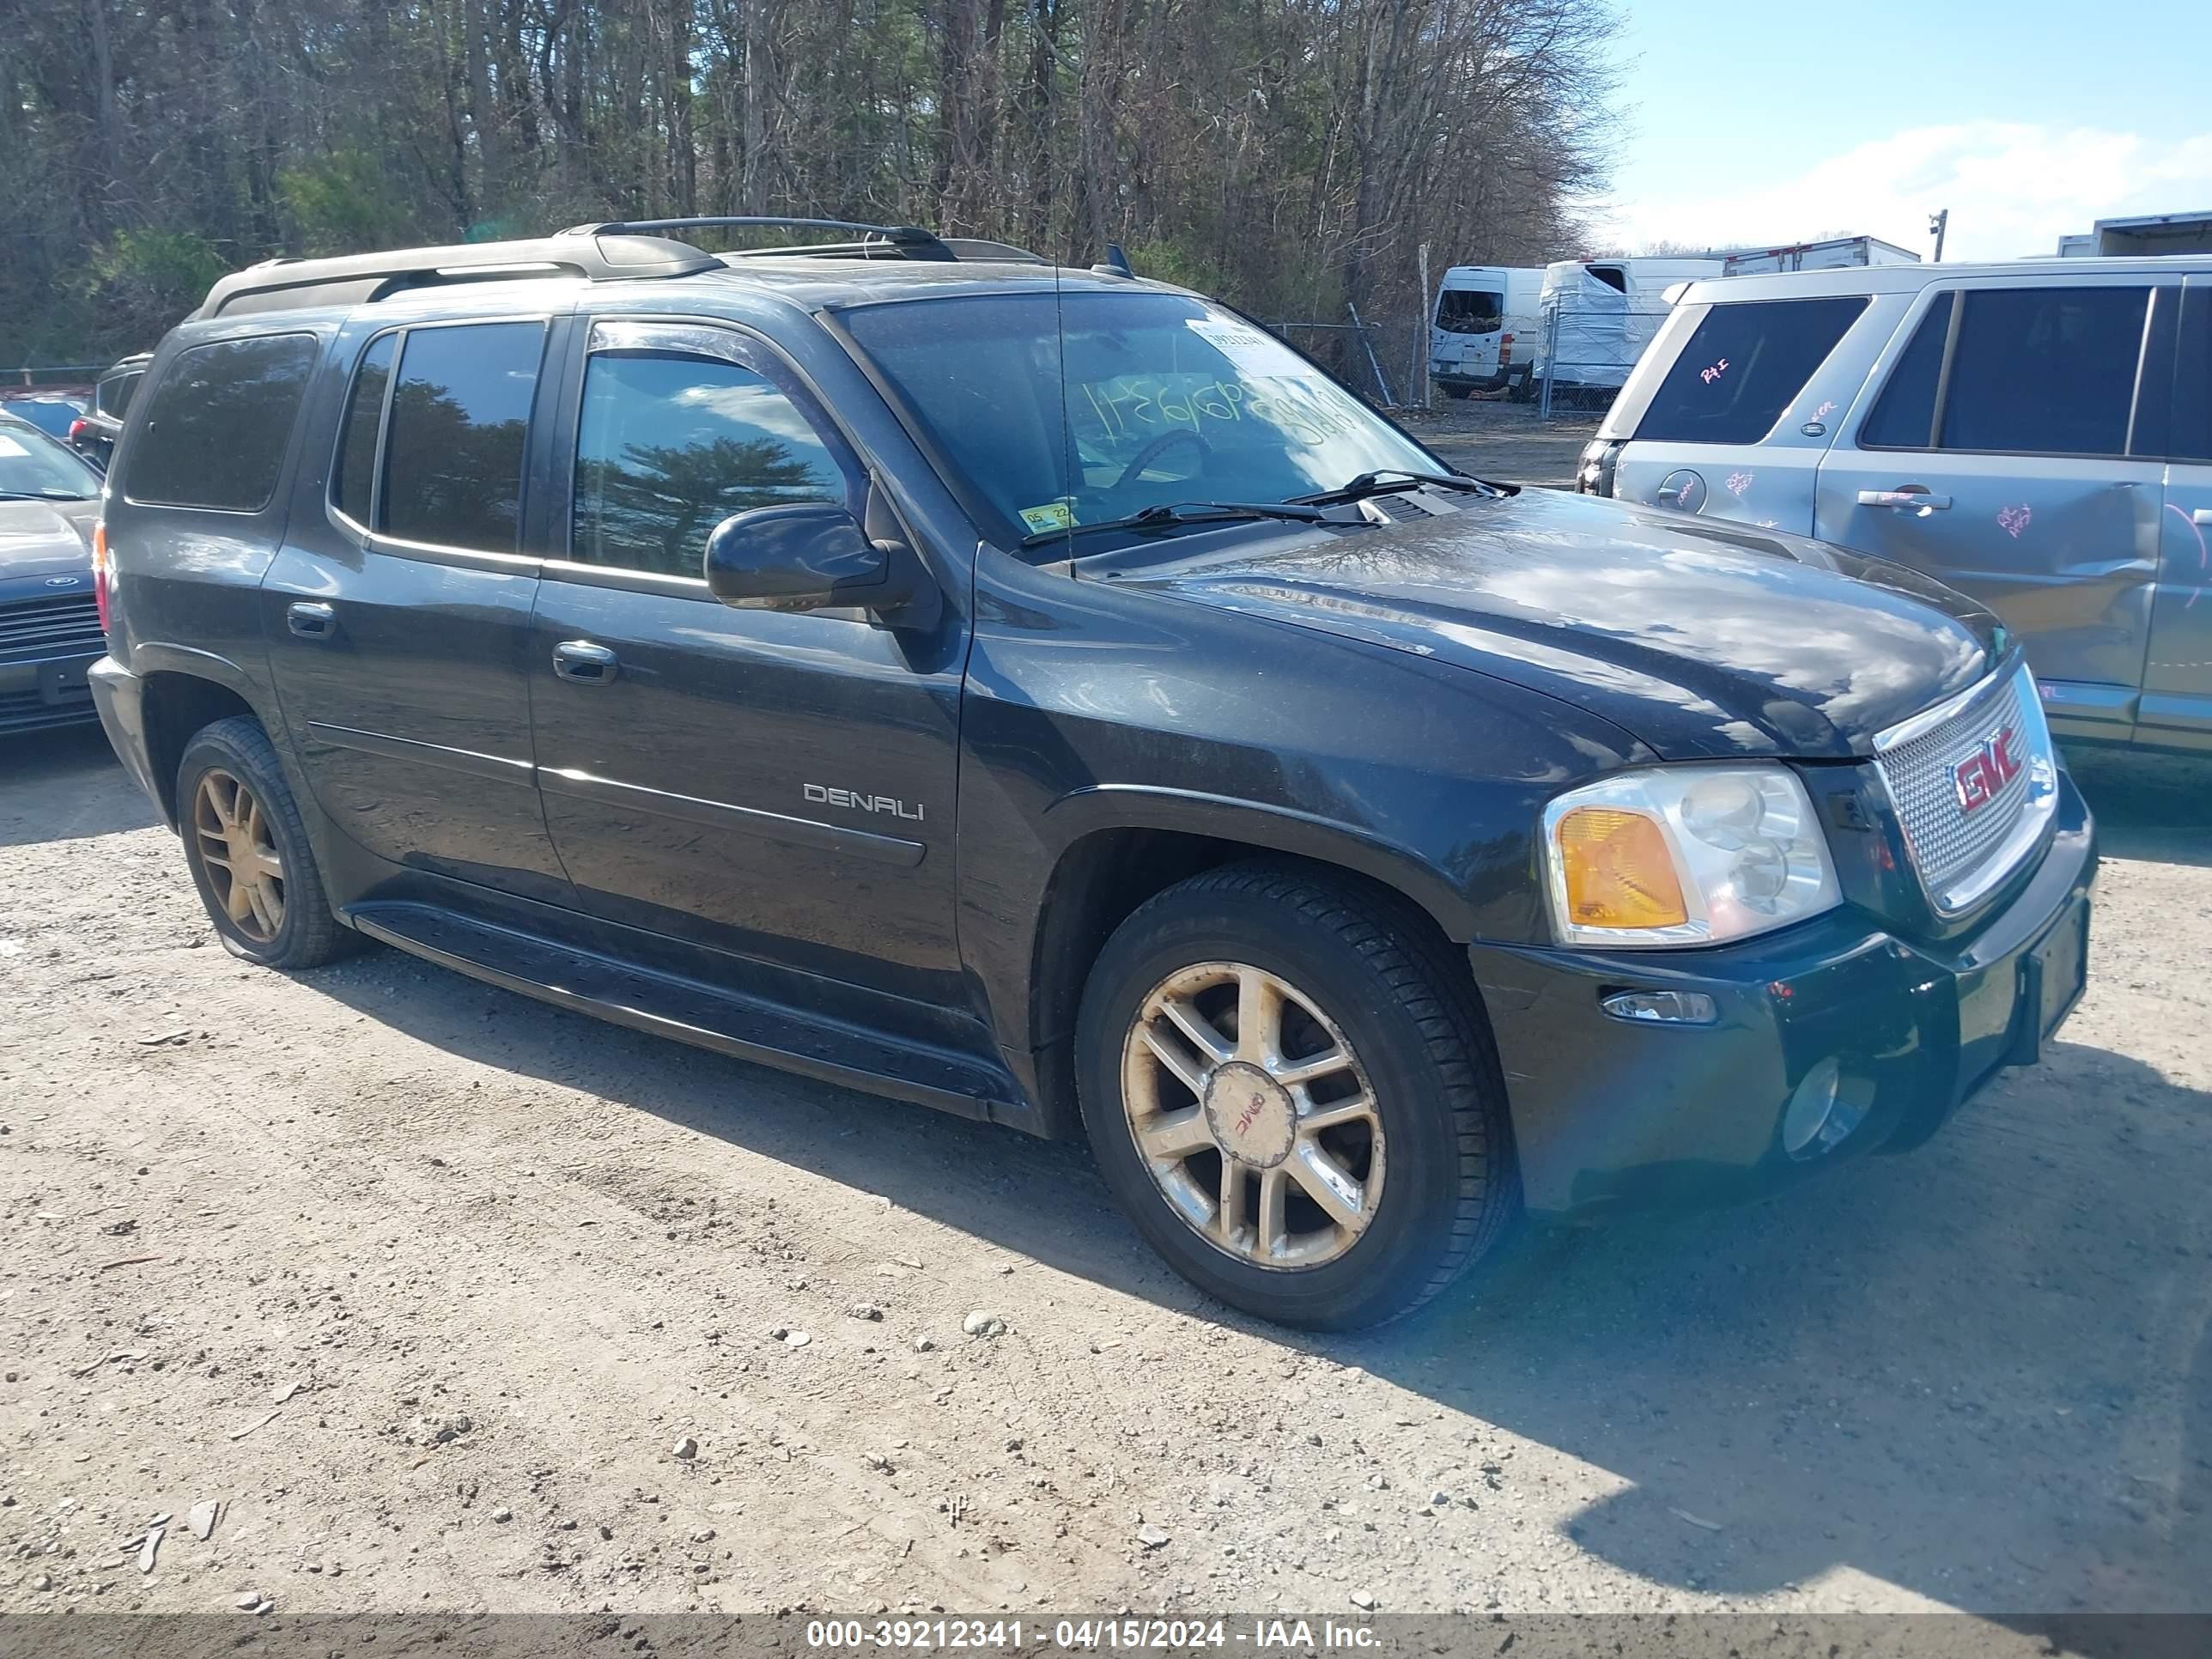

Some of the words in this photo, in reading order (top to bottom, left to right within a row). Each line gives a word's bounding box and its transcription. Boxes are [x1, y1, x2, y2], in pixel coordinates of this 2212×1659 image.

[1954, 728, 2021, 811] GMC
[804, 783, 924, 821] DENALI
[1235, 1092, 1266, 1135] GMC
